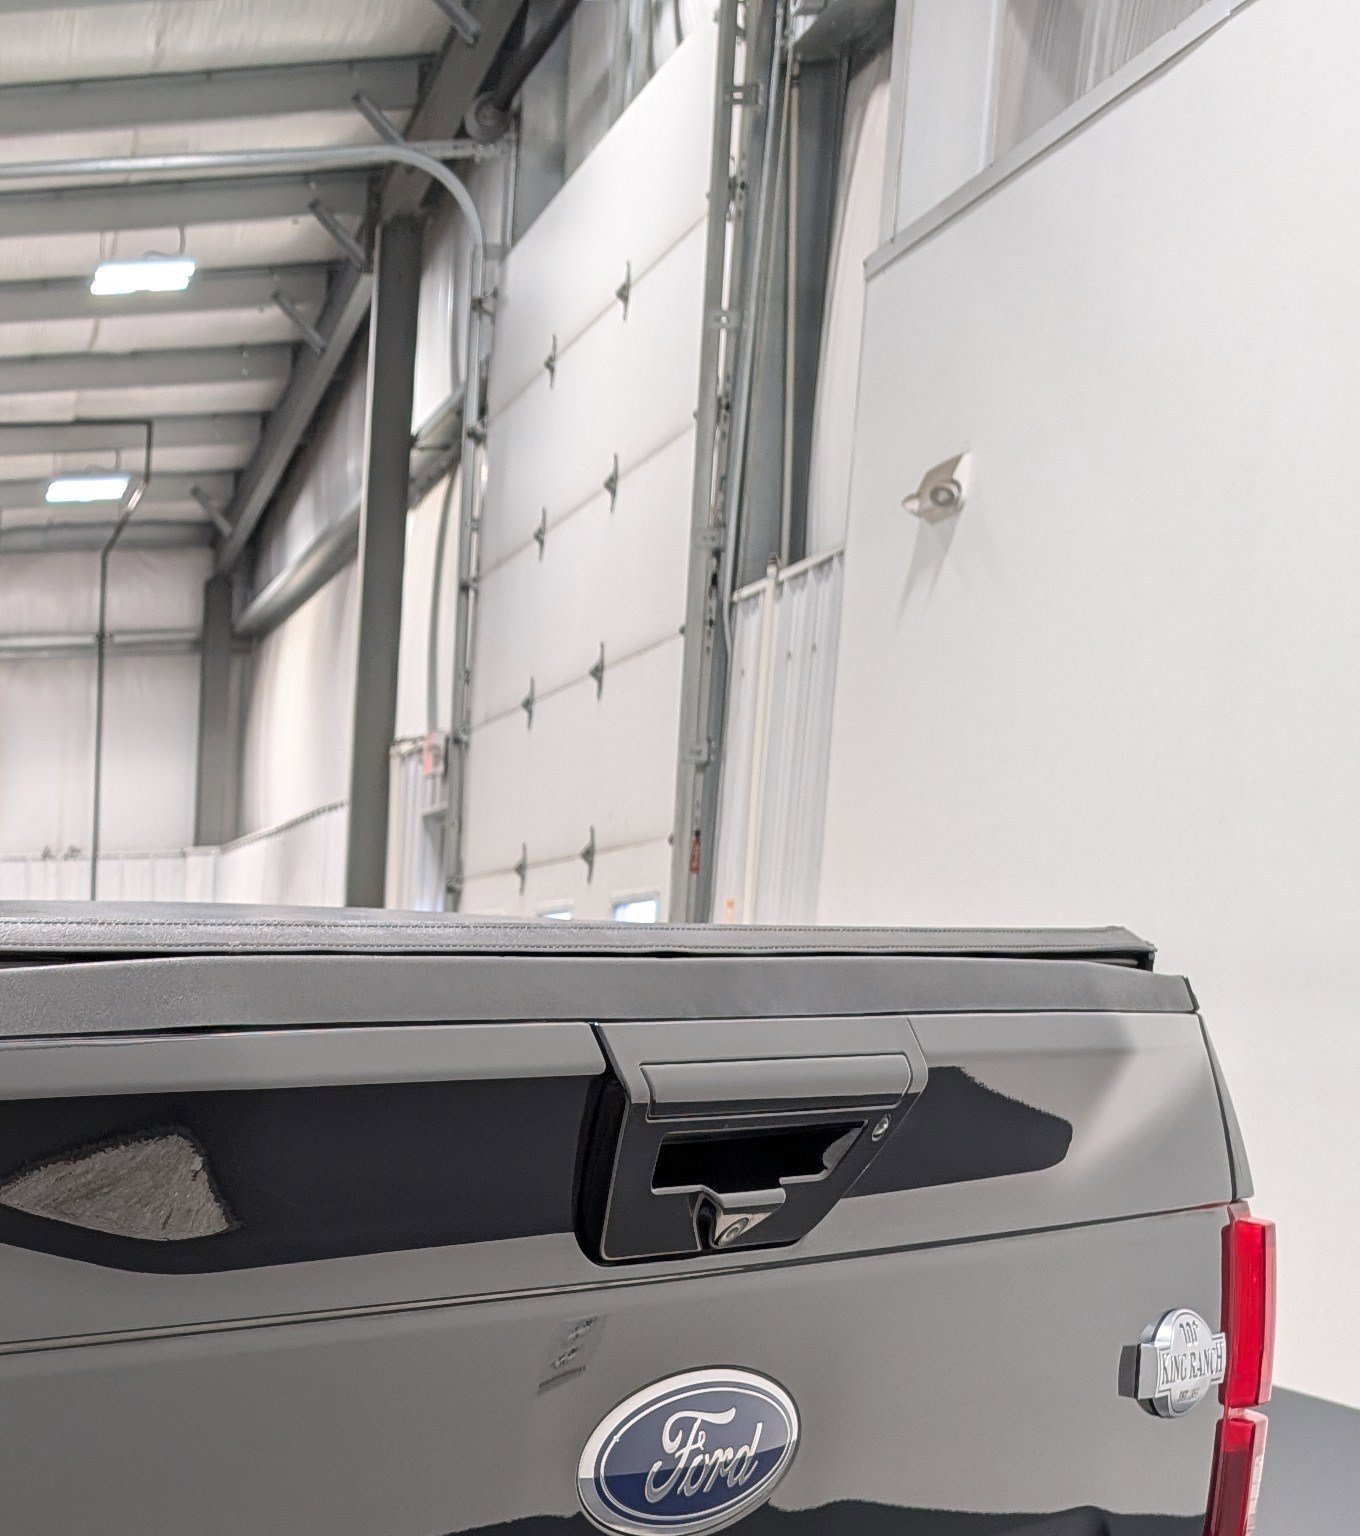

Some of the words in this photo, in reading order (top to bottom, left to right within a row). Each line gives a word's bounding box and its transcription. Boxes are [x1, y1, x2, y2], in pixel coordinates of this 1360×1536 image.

[1161, 1352, 1188, 1385] KING
[1189, 1341, 1223, 1380] RANCH
[644, 1405, 764, 1503] Ford
